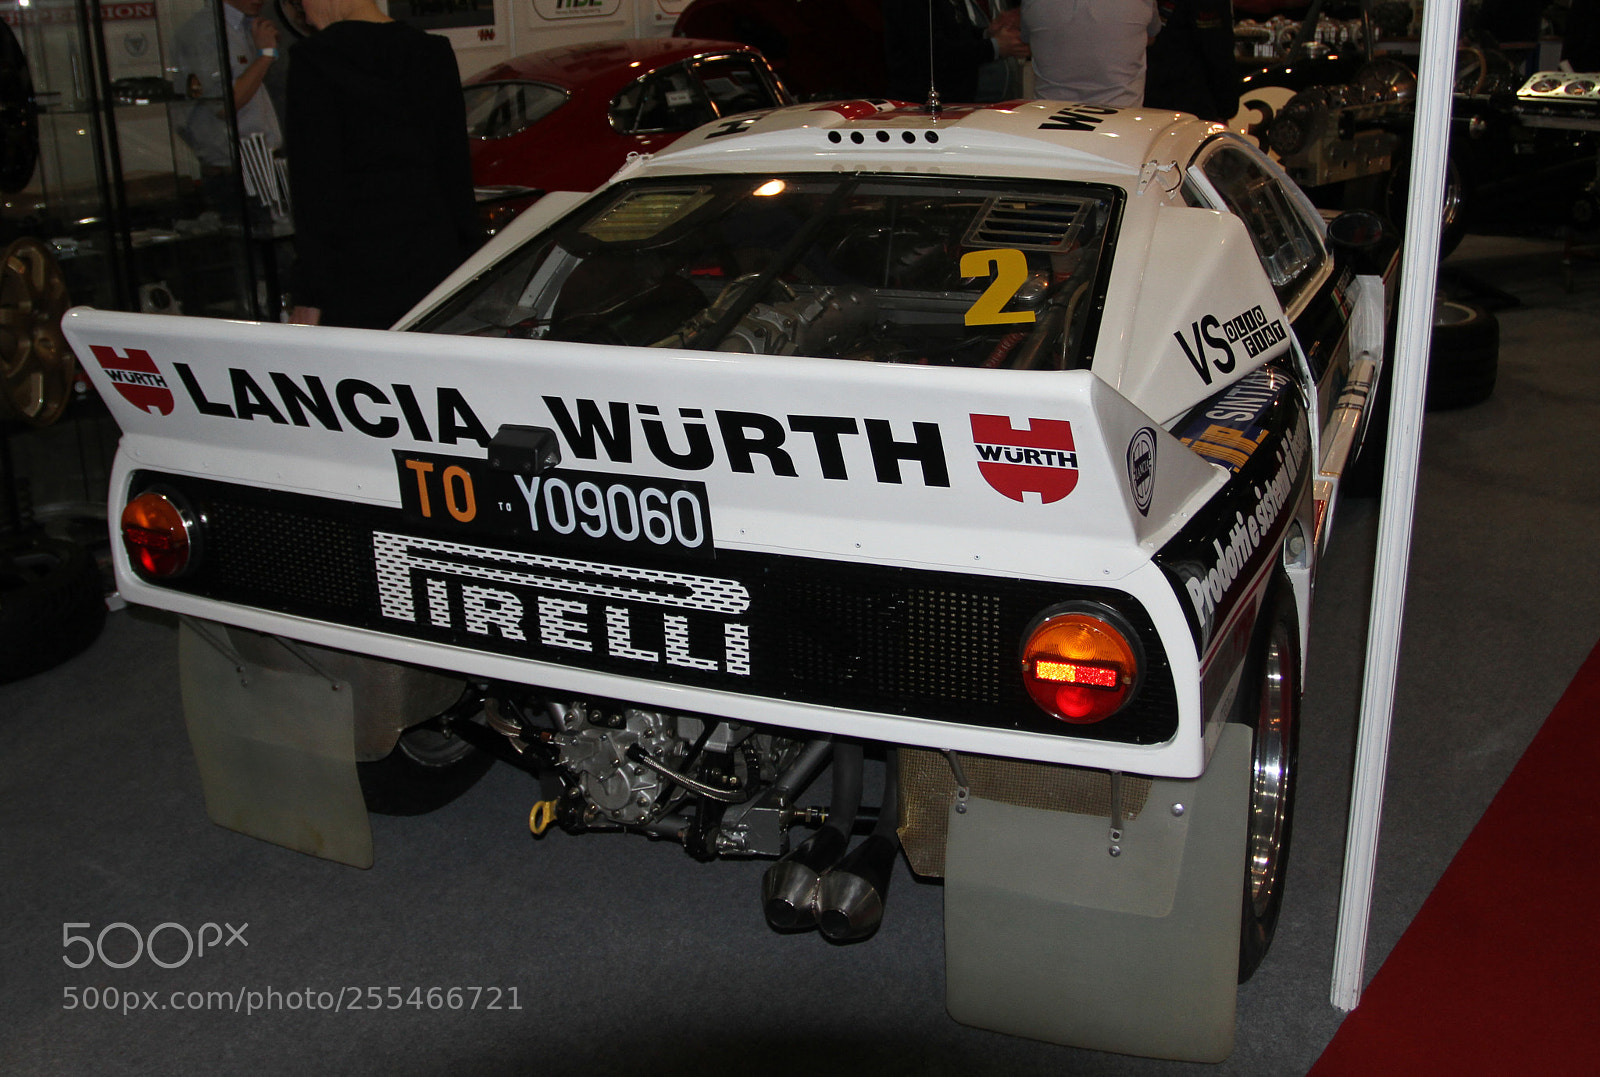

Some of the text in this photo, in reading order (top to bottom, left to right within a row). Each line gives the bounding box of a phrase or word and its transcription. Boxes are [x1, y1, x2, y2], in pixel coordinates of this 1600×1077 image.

[960, 248, 1036, 327] 2
[1174, 314, 1236, 386] VS
[1223, 306, 1267, 343] OLIO
[1242, 319, 1287, 358] FIAT
[104, 369, 168, 388] WÜRTH
[172, 361, 950, 488] LANCIA WÜRTH
[975, 444, 1078, 468] WÜRTH
[405, 459, 477, 523] TO
[497, 501, 512, 512] TO
[373, 531, 751, 675] PIRELLI
